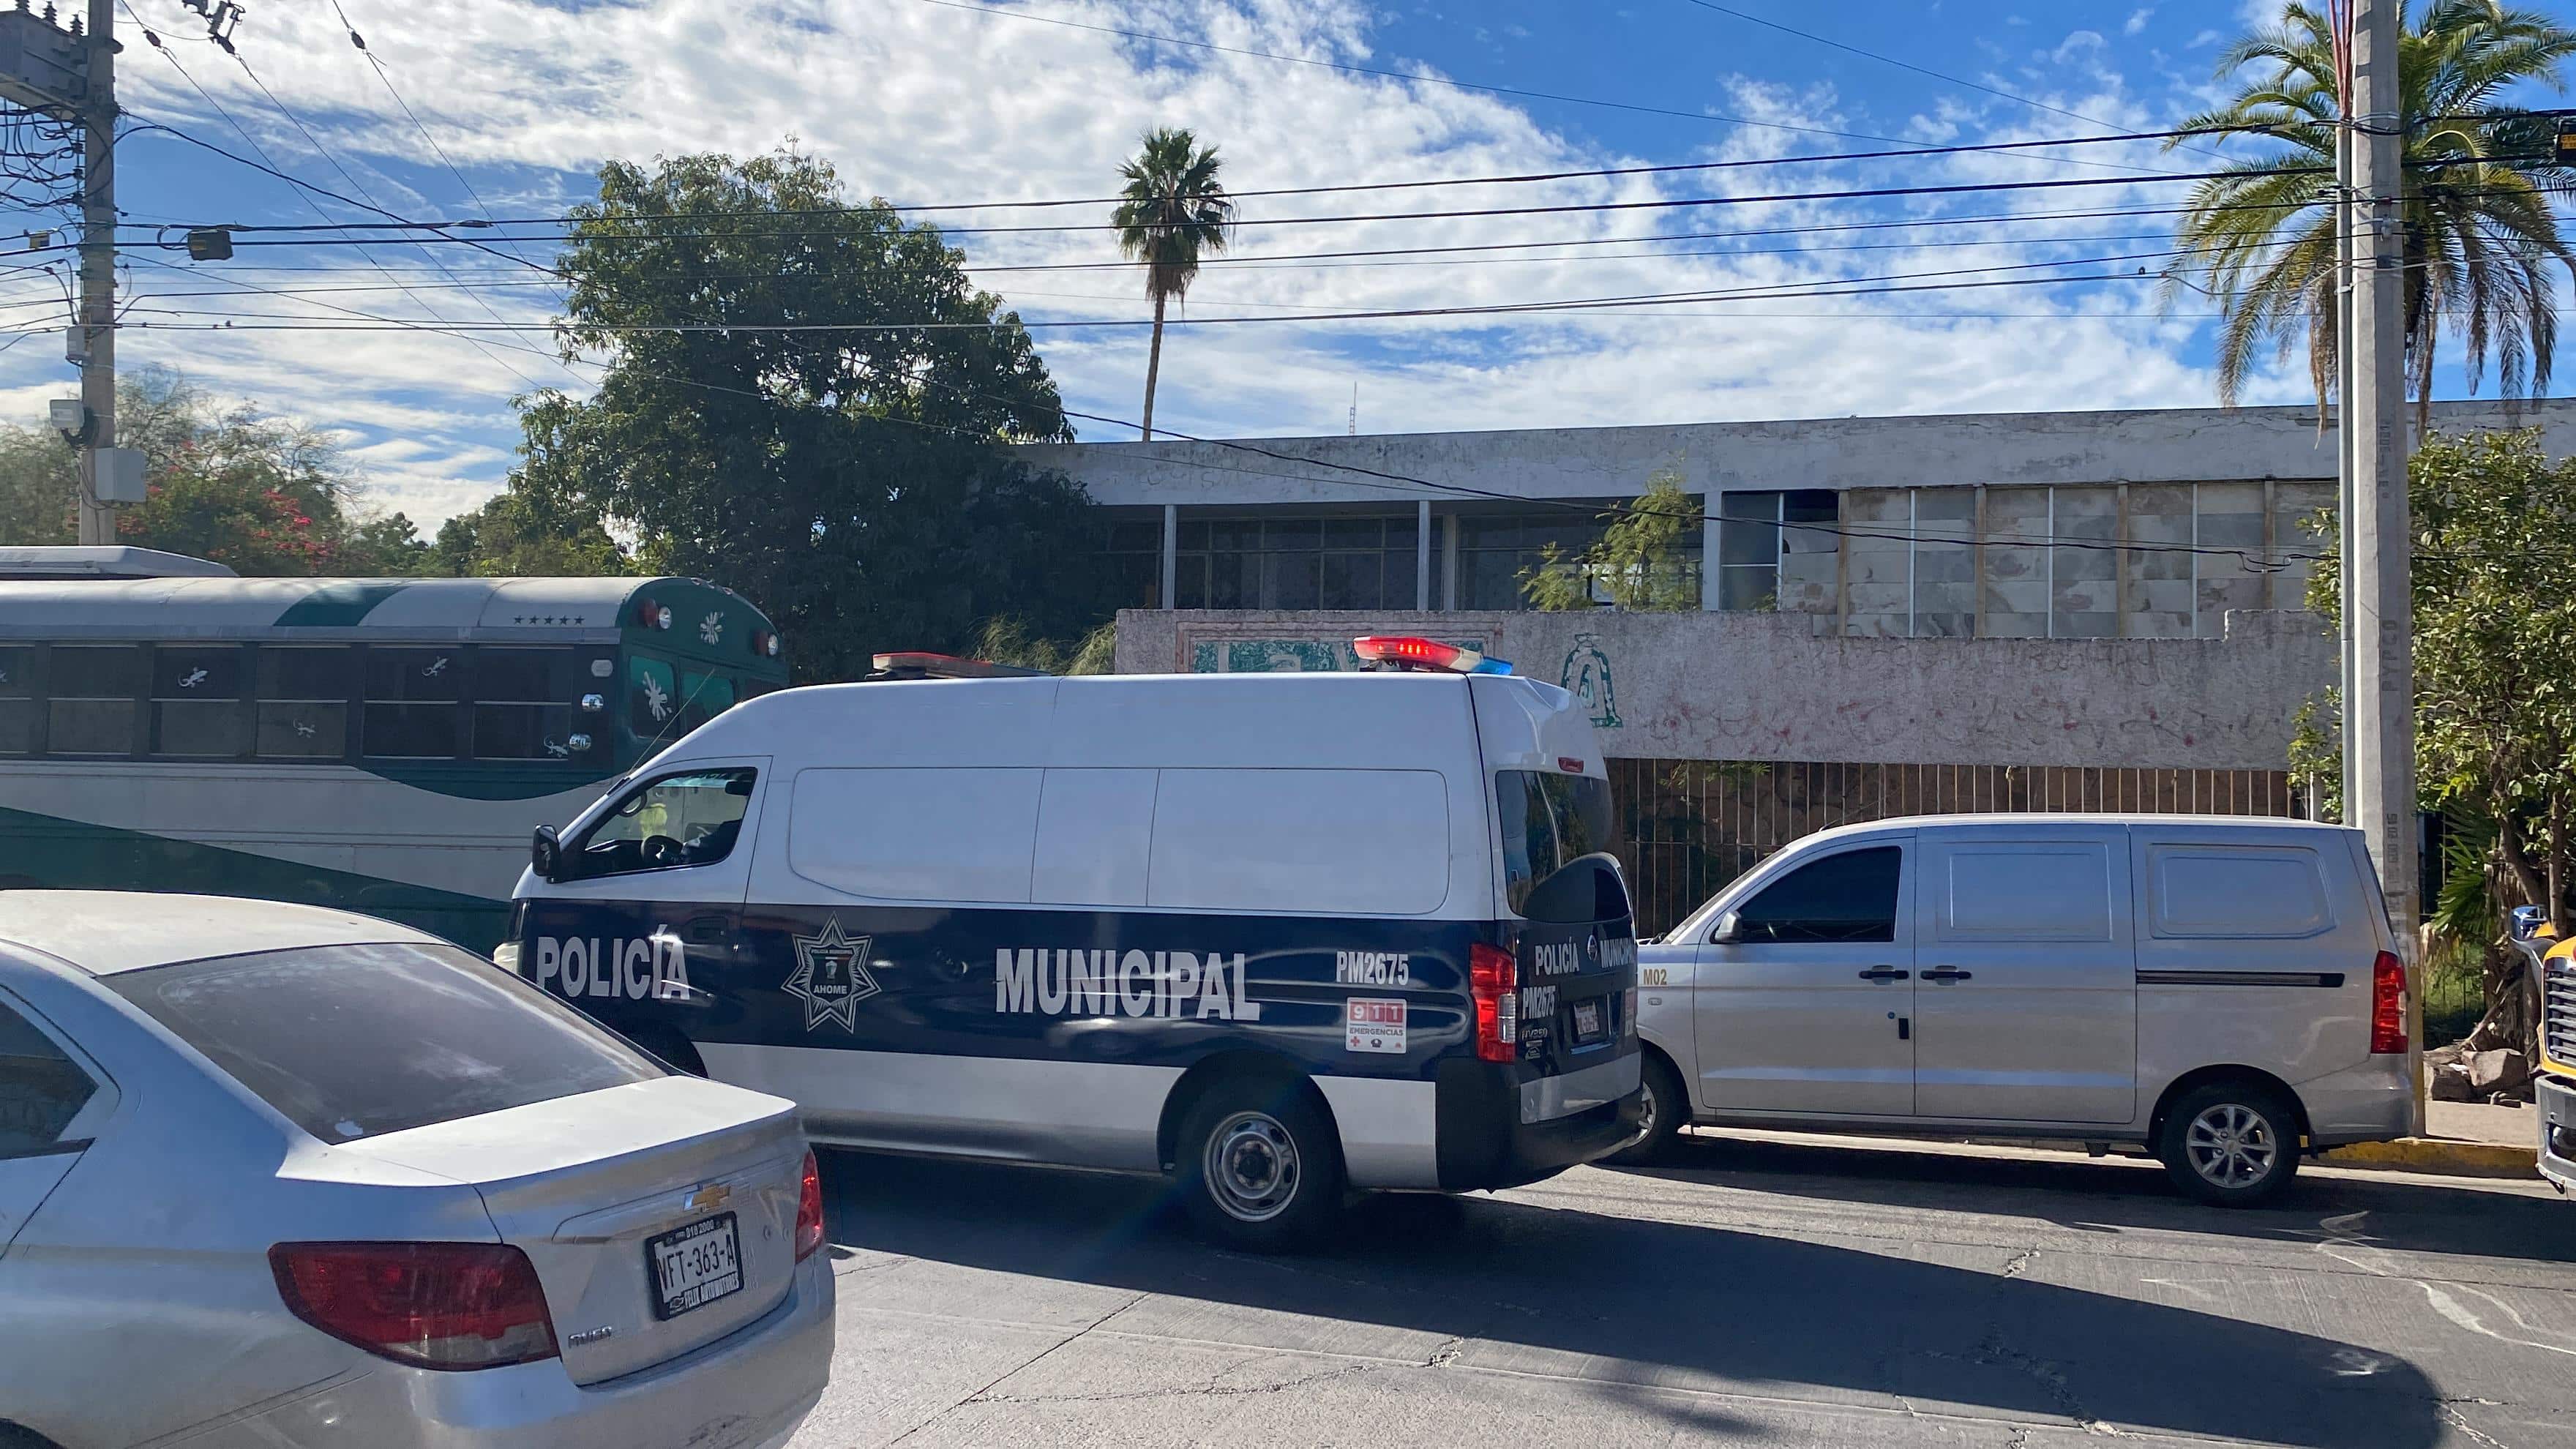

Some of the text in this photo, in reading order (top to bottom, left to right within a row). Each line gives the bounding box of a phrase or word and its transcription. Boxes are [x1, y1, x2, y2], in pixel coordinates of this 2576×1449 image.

[537, 924, 690, 1000] POLICÍA
[1336, 951, 1409, 986] PM2675
[1535, 937, 1580, 976] POLICÍA
[814, 985, 847, 995] AHOME
[995, 948, 1260, 1021] MUNICIPAL
[1643, 968, 1667, 986] M02
[1353, 1004, 1399, 1021] 911
[1522, 986, 1556, 1020] PM2675
[1349, 1027, 1404, 1036] EMERGENCIAS
[658, 1234, 735, 1290] VFT-363-A
